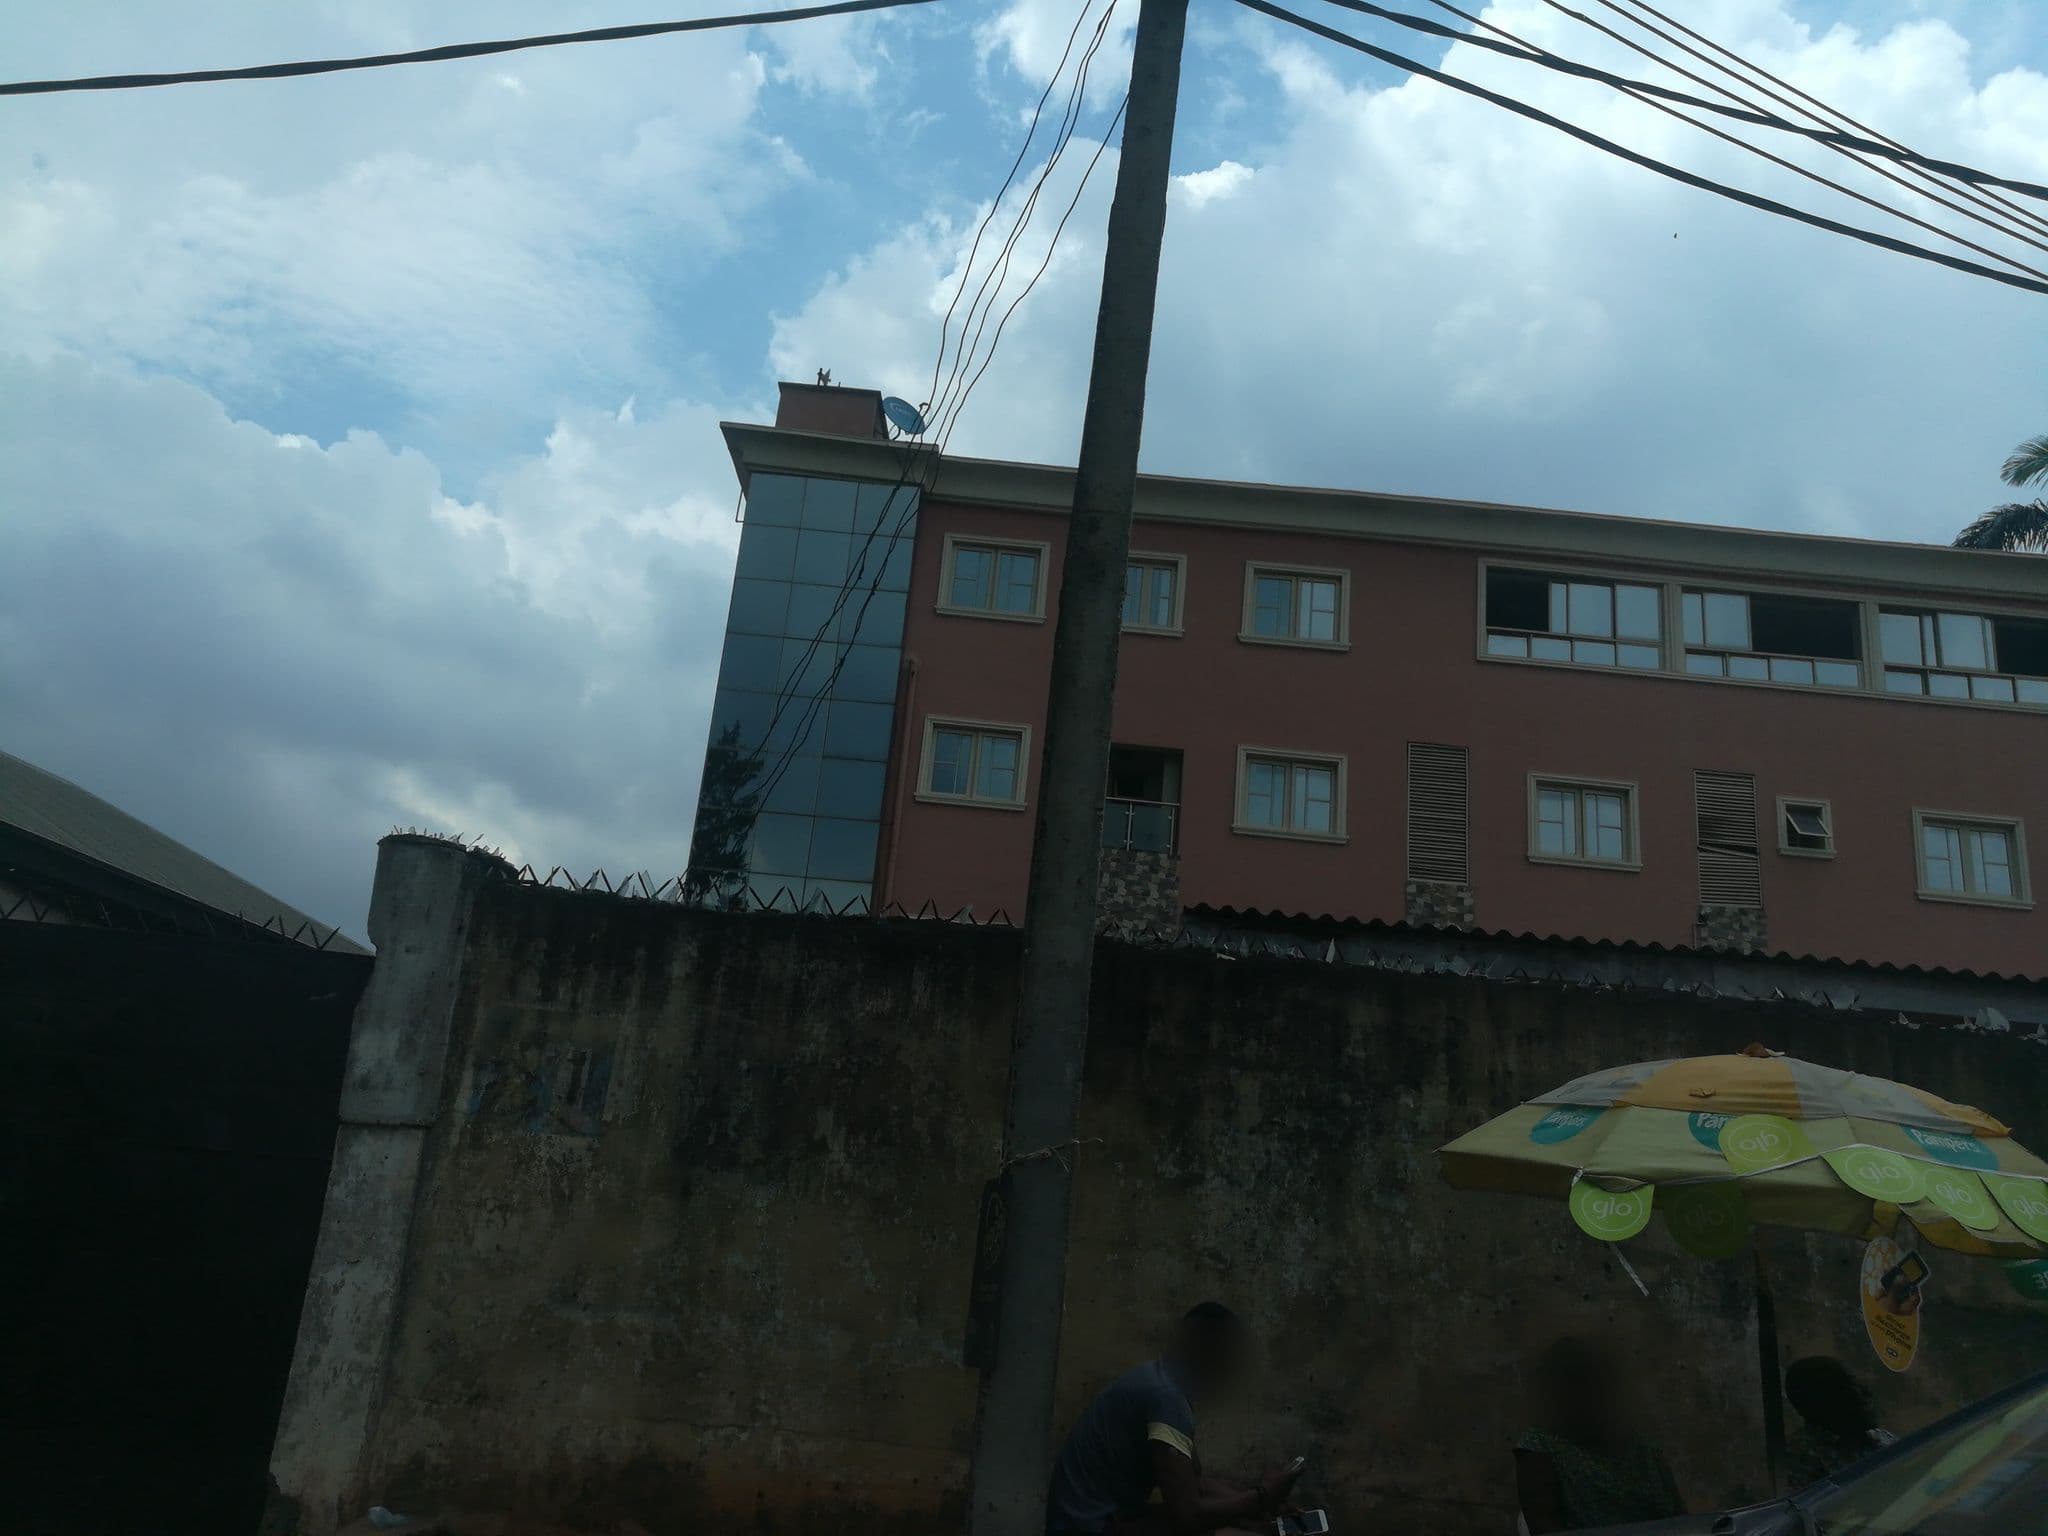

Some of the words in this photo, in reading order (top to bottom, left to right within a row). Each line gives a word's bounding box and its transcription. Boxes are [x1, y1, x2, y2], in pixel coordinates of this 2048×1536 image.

[1859, 1161, 1899, 1184] glo
[1936, 1181, 1972, 1204] glo
[1593, 1197, 1632, 1219] glo
